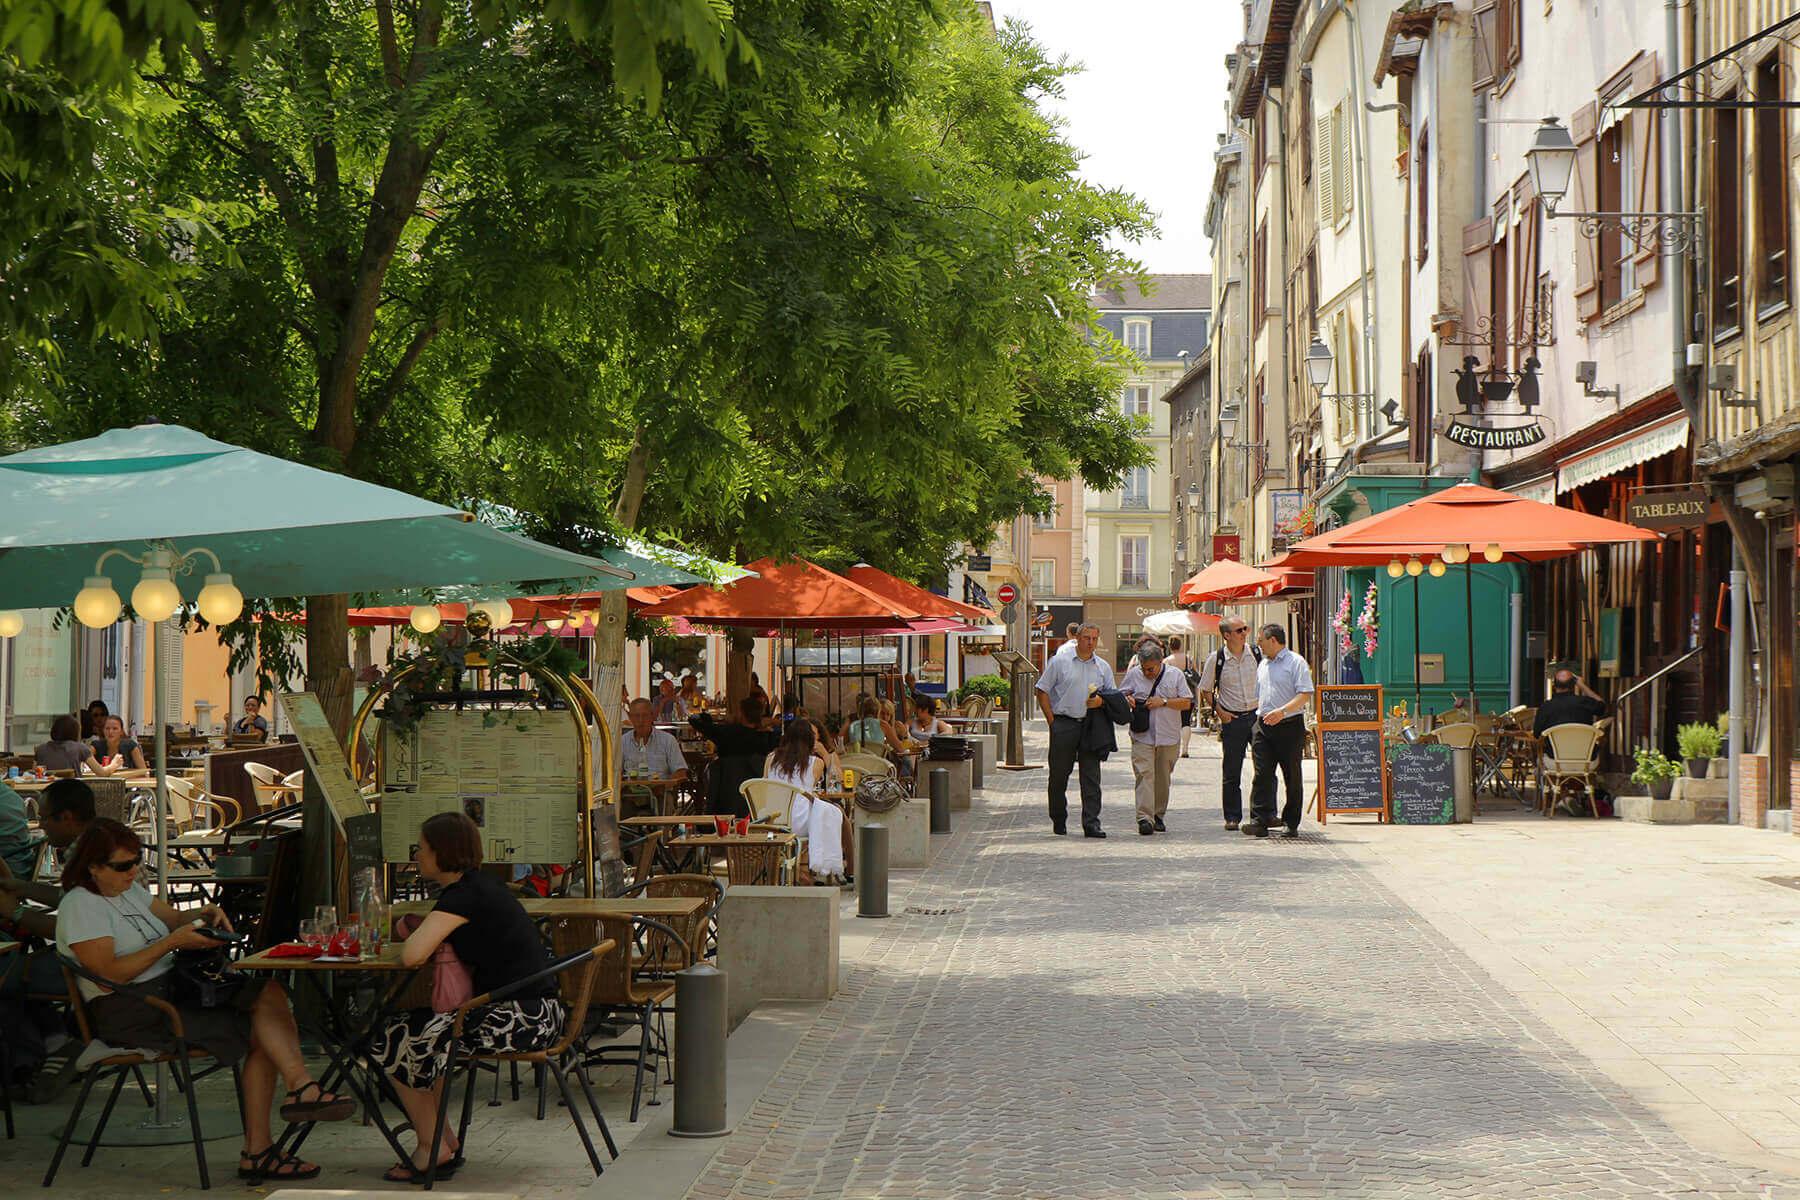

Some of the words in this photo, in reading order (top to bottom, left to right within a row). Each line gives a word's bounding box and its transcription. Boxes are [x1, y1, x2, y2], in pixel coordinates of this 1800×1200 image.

[1450, 424, 1543, 447] RESTAURANT
[1632, 501, 1705, 518] TABLEAUX
[1322, 691, 1374, 701] Restaurant
